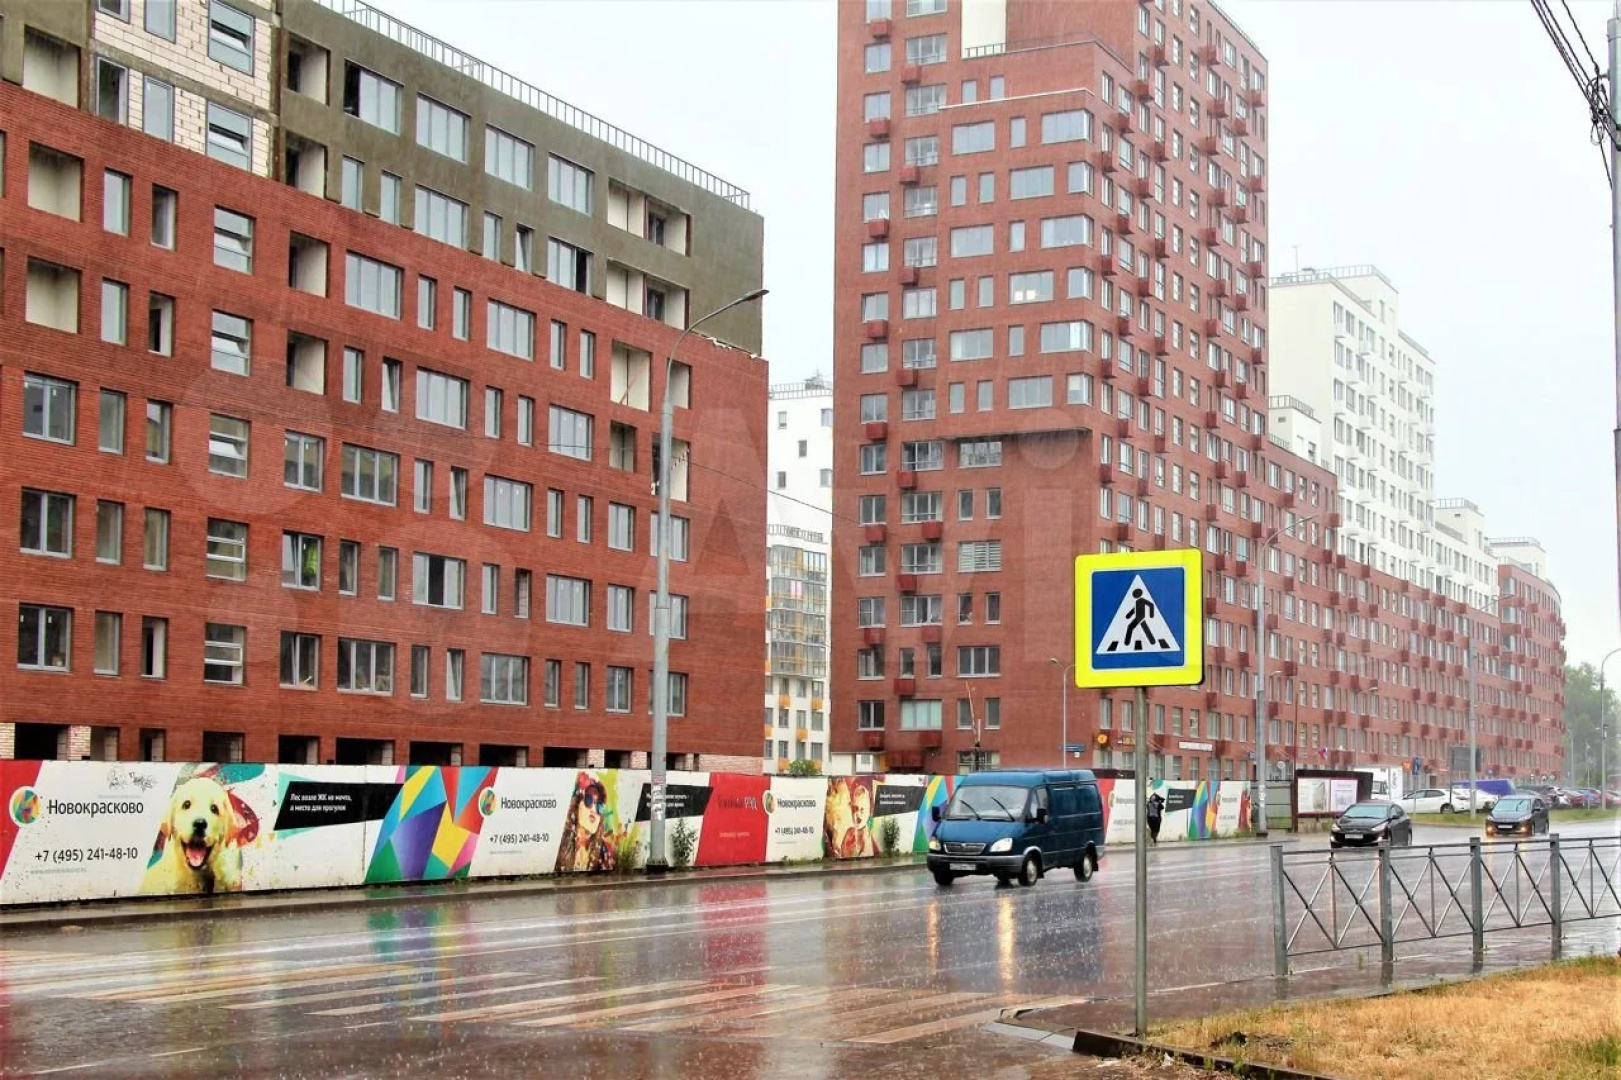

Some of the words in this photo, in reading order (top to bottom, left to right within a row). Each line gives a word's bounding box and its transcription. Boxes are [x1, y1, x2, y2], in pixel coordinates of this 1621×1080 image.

[48, 799, 144, 818] Новокрасково
[501, 796, 557, 812] Новокрасково
[489, 834, 498, 844] +7
[499, 833, 518, 845] (495)
[35, 850, 49, 862] +7
[52, 848, 84, 863] (495)
[87, 847, 138, 860] 241-48-10
